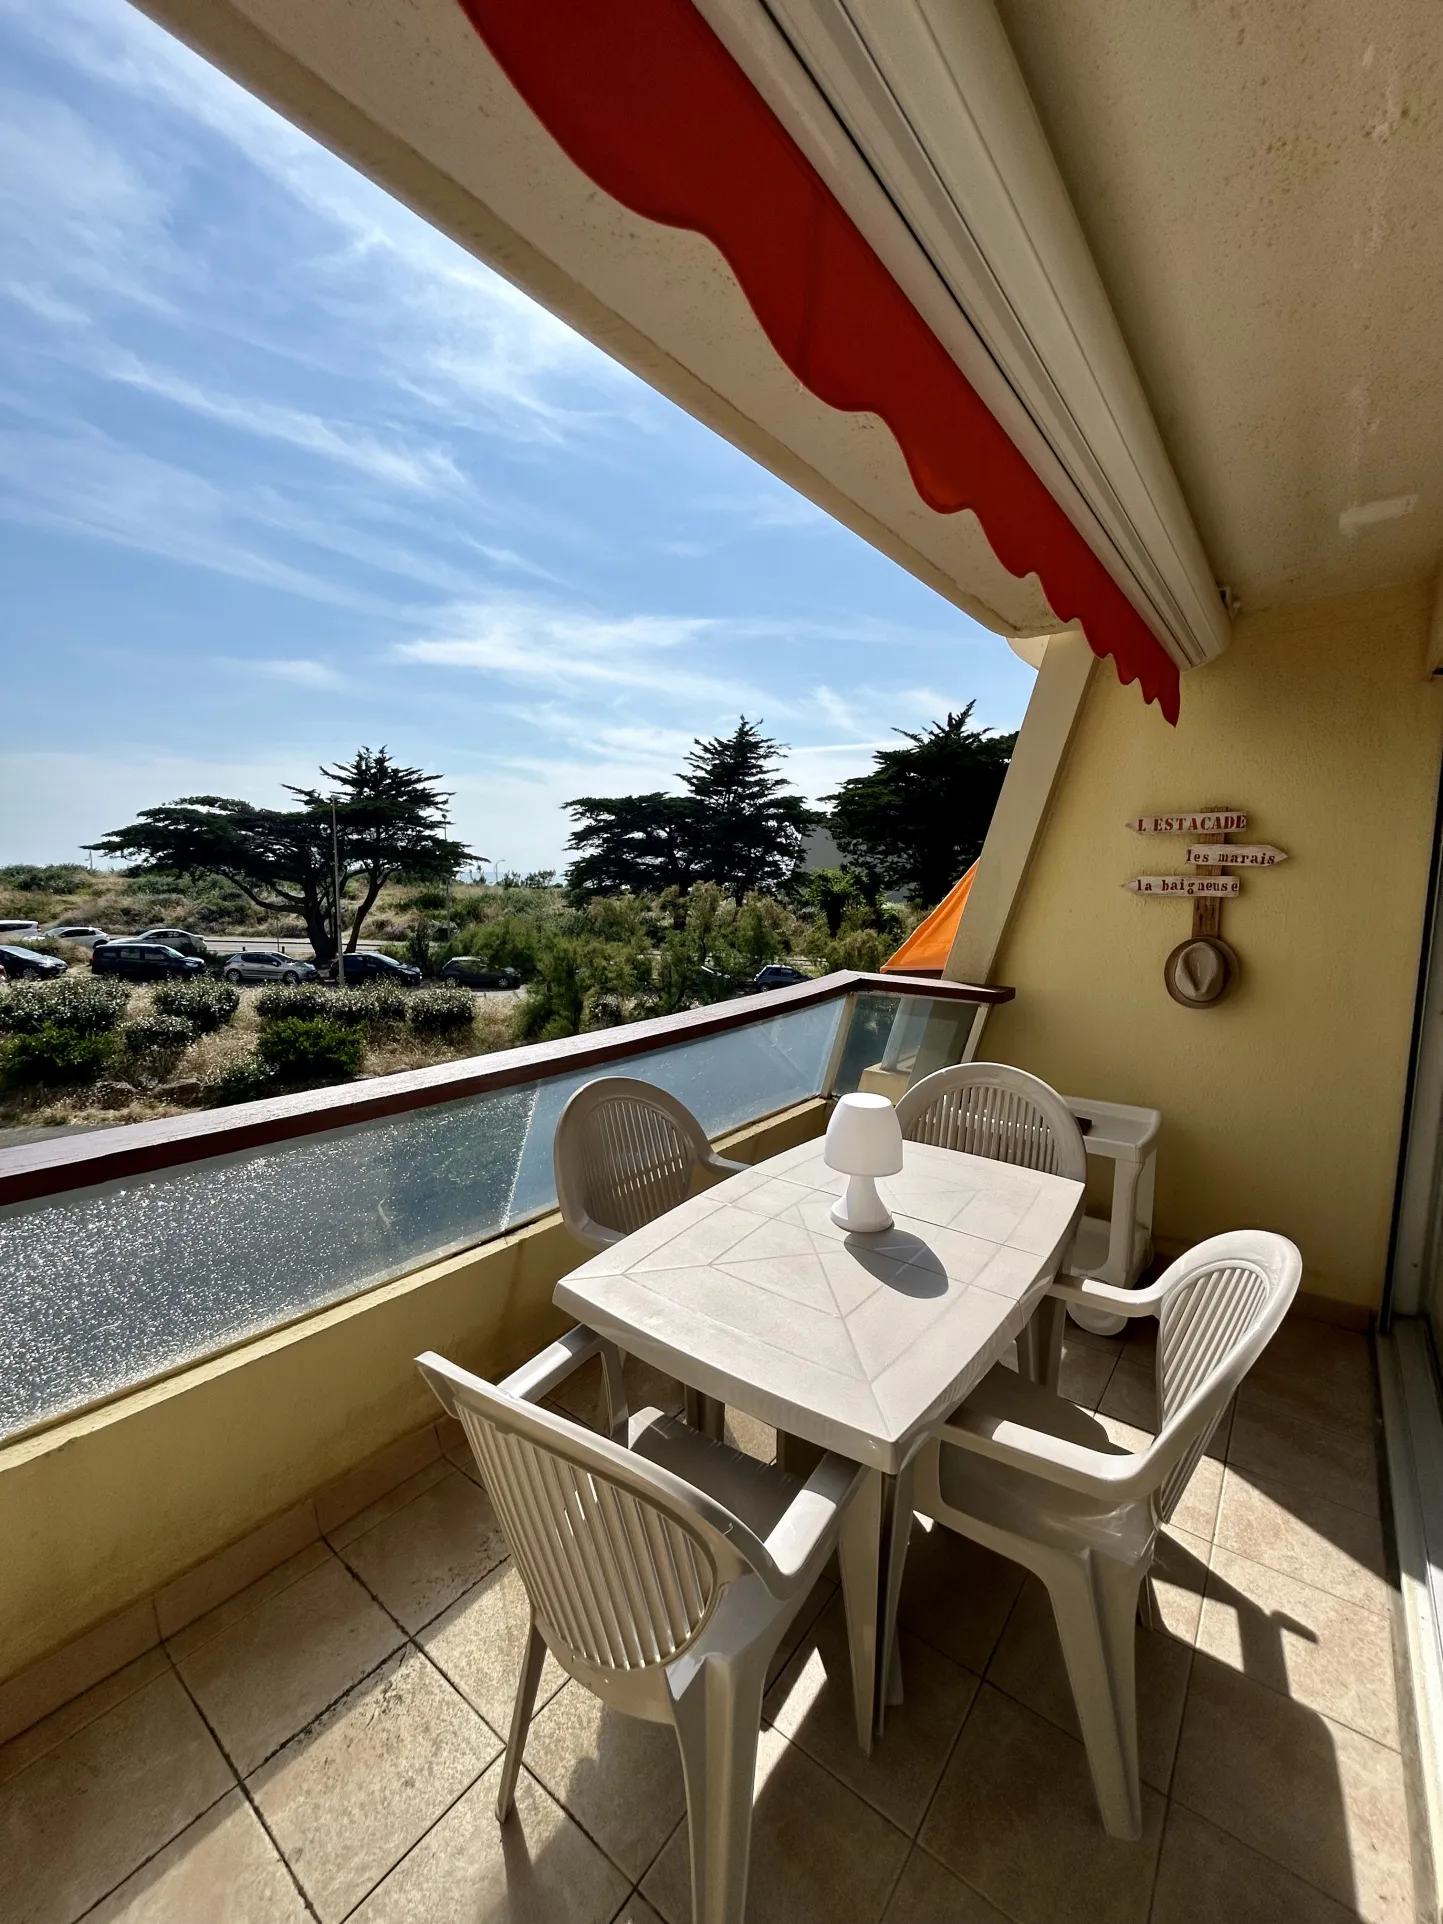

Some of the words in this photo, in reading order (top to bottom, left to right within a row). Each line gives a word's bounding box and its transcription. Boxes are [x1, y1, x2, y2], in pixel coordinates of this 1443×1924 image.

[1186, 849, 1210, 863] les
[1218, 853, 1276, 865] marais
[1137, 879, 1152, 891] la
[1161, 879, 1238, 895] baigneuse
